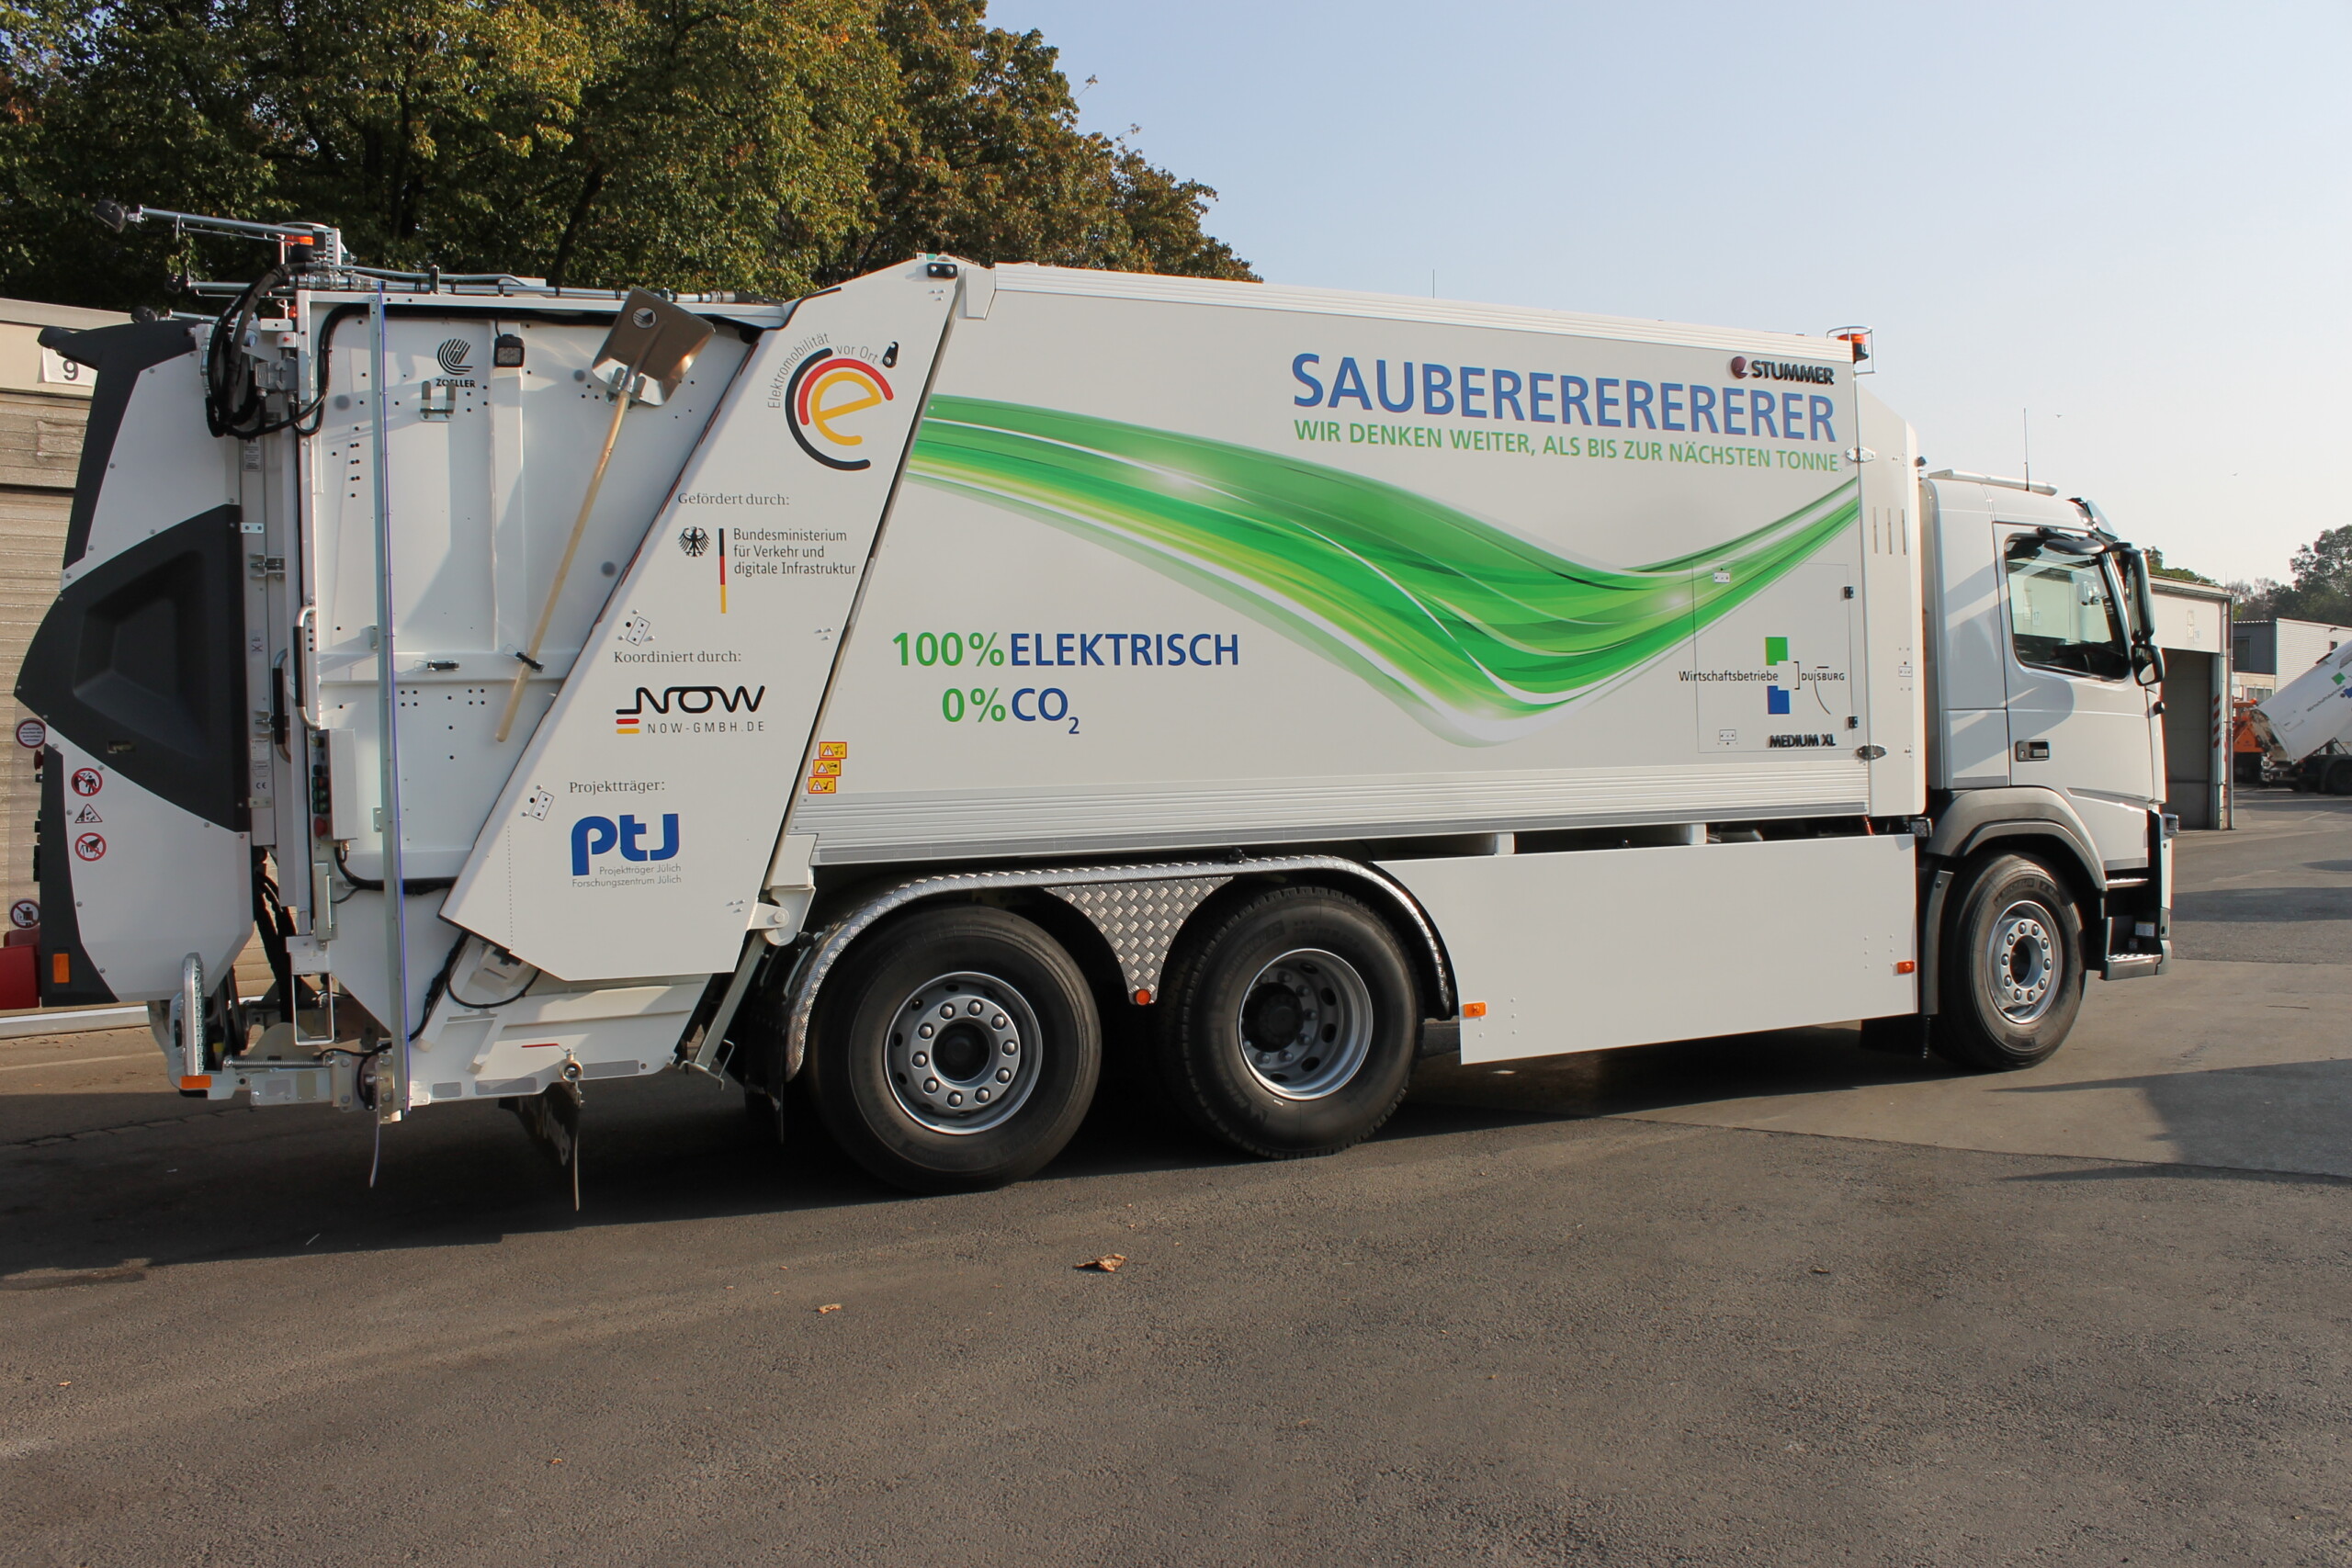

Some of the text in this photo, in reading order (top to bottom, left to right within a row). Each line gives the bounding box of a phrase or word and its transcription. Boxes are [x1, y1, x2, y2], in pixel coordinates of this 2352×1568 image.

[62, 359, 79, 381] 9
[767, 333, 878, 409] Elektromobilität vor Ort
[1751, 360, 1835, 385] STUMMER
[1292, 353, 1837, 444] SAUBERERERERERER
[1294, 420, 1341, 442] WIR
[1349, 423, 1442, 448] DENKEN
[1449, 429, 1536, 457] WEITER,
[1543, 435, 1580, 457] ALS
[1588, 438, 1617, 458] BIS
[1623, 441, 1663, 461] ZUR
[1668, 441, 1771, 468] NÄCHSTEN
[678, 492, 790, 505] Gefördert durch:
[734, 528, 847, 541] Bundesministerium
[734, 545, 825, 558] für Verkehr und
[734, 561, 856, 577] digitale Infrastruktur
[614, 650, 741, 663] Koordiniert durch:
[892, 632, 1239, 666] 100% ELEKTRISCH
[1679, 670, 1779, 682] Wirtschaftsbetriebe
[616, 685, 765, 714] NOW
[942, 687, 1006, 723] 0%
[647, 720, 764, 734] NOW-GMBH.DE
[1768, 733, 1837, 749] MEDIUM XL
[569, 780, 665, 795] Projektträger:
[599, 863, 681, 877] Projektträger Jülich
[571, 874, 682, 888] Forschungszentrum Jülich
